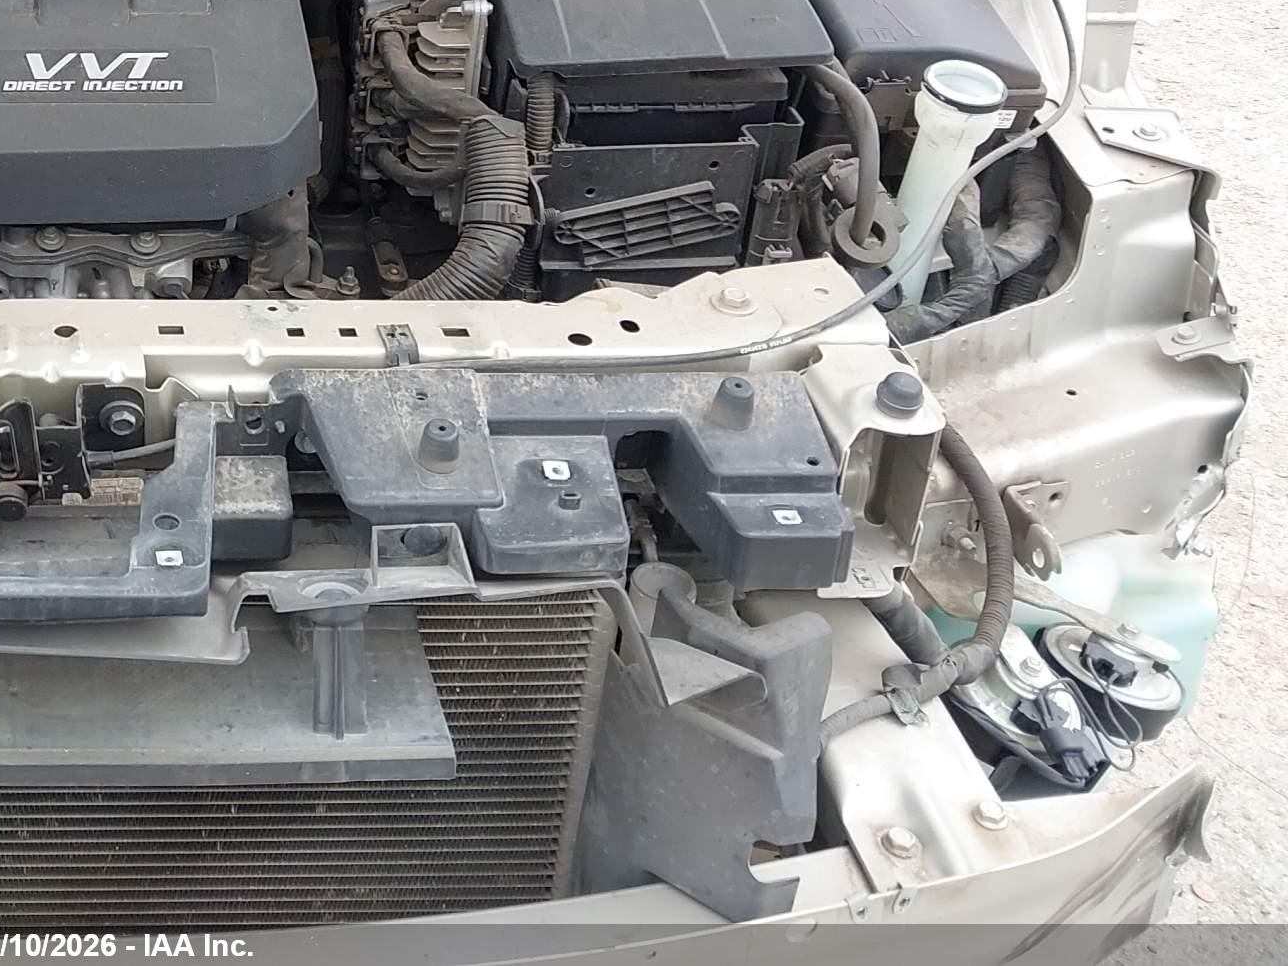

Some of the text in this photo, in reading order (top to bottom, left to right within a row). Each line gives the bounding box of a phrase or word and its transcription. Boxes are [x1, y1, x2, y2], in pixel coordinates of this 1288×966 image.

[25, 52, 169, 79] VVT
[3, 80, 184, 91] DIRECT INJECTION
